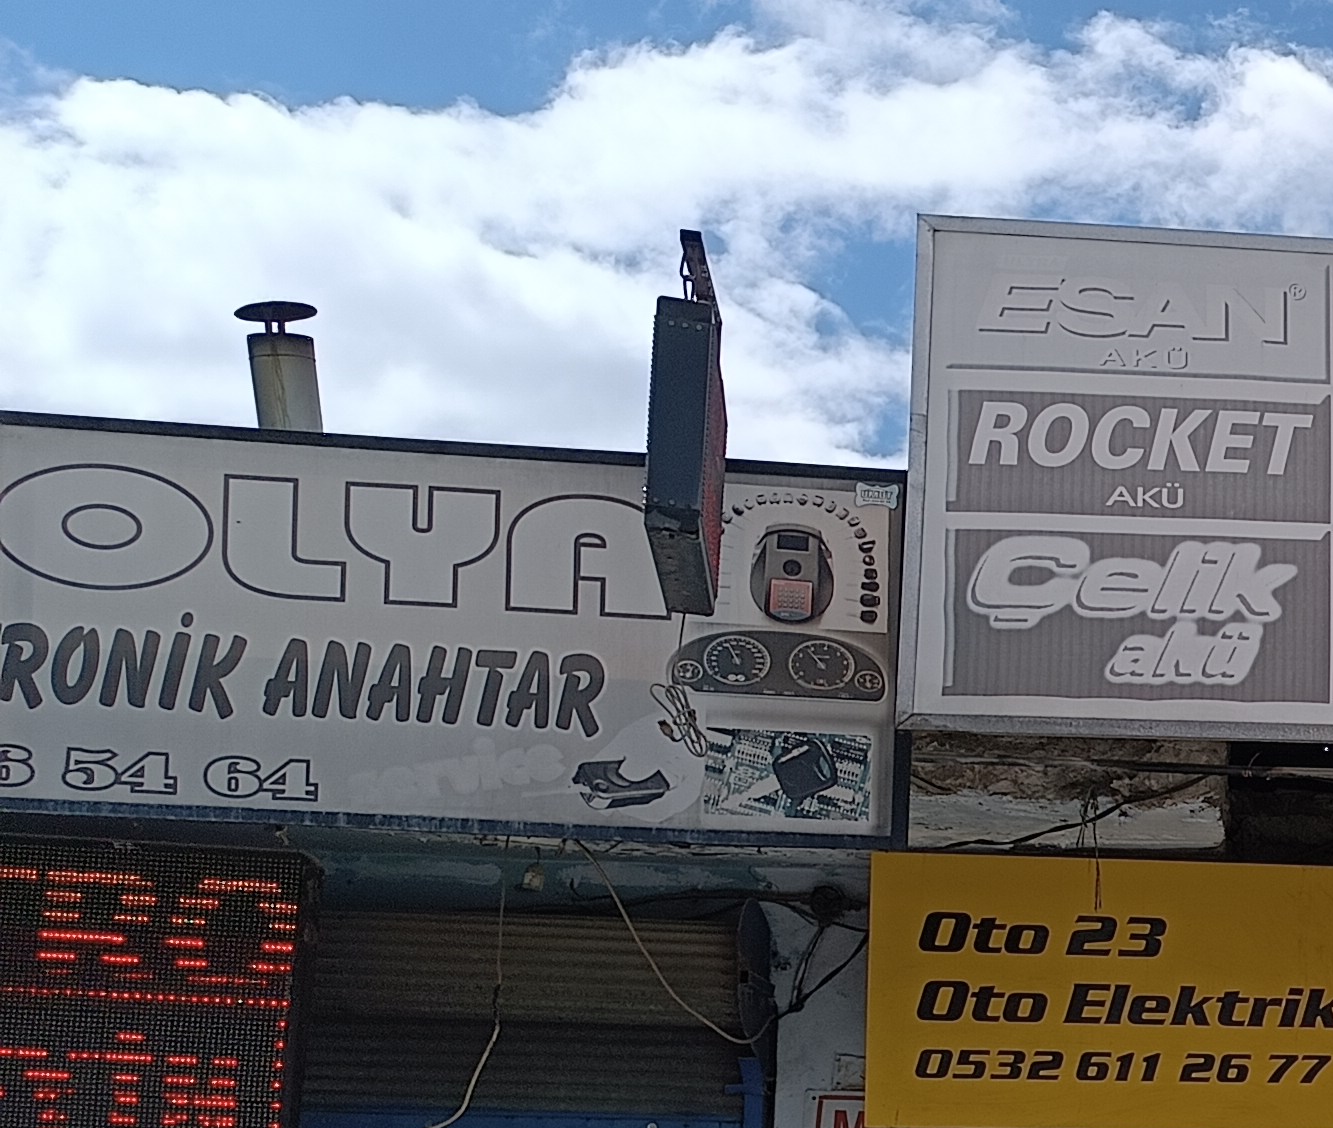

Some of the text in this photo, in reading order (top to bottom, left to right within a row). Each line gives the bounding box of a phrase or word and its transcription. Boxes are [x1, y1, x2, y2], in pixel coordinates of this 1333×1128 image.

[975, 270, 1289, 346] ESAN
[1099, 347, 1190, 369] AKÜ
[967, 401, 1315, 475] ROCKET
[1106, 484, 1185, 509] AKÜ
[0, 463, 672, 621] OLYA
[262, 639, 606, 738] ANAHTAR
[62, 746, 178, 796] 54
[203, 755, 319, 802] 64
[918, 910, 1168, 958] Oto 23
[916, 979, 1049, 1024] Oto
[914, 1049, 1332, 1085] 0532 611 26 77
